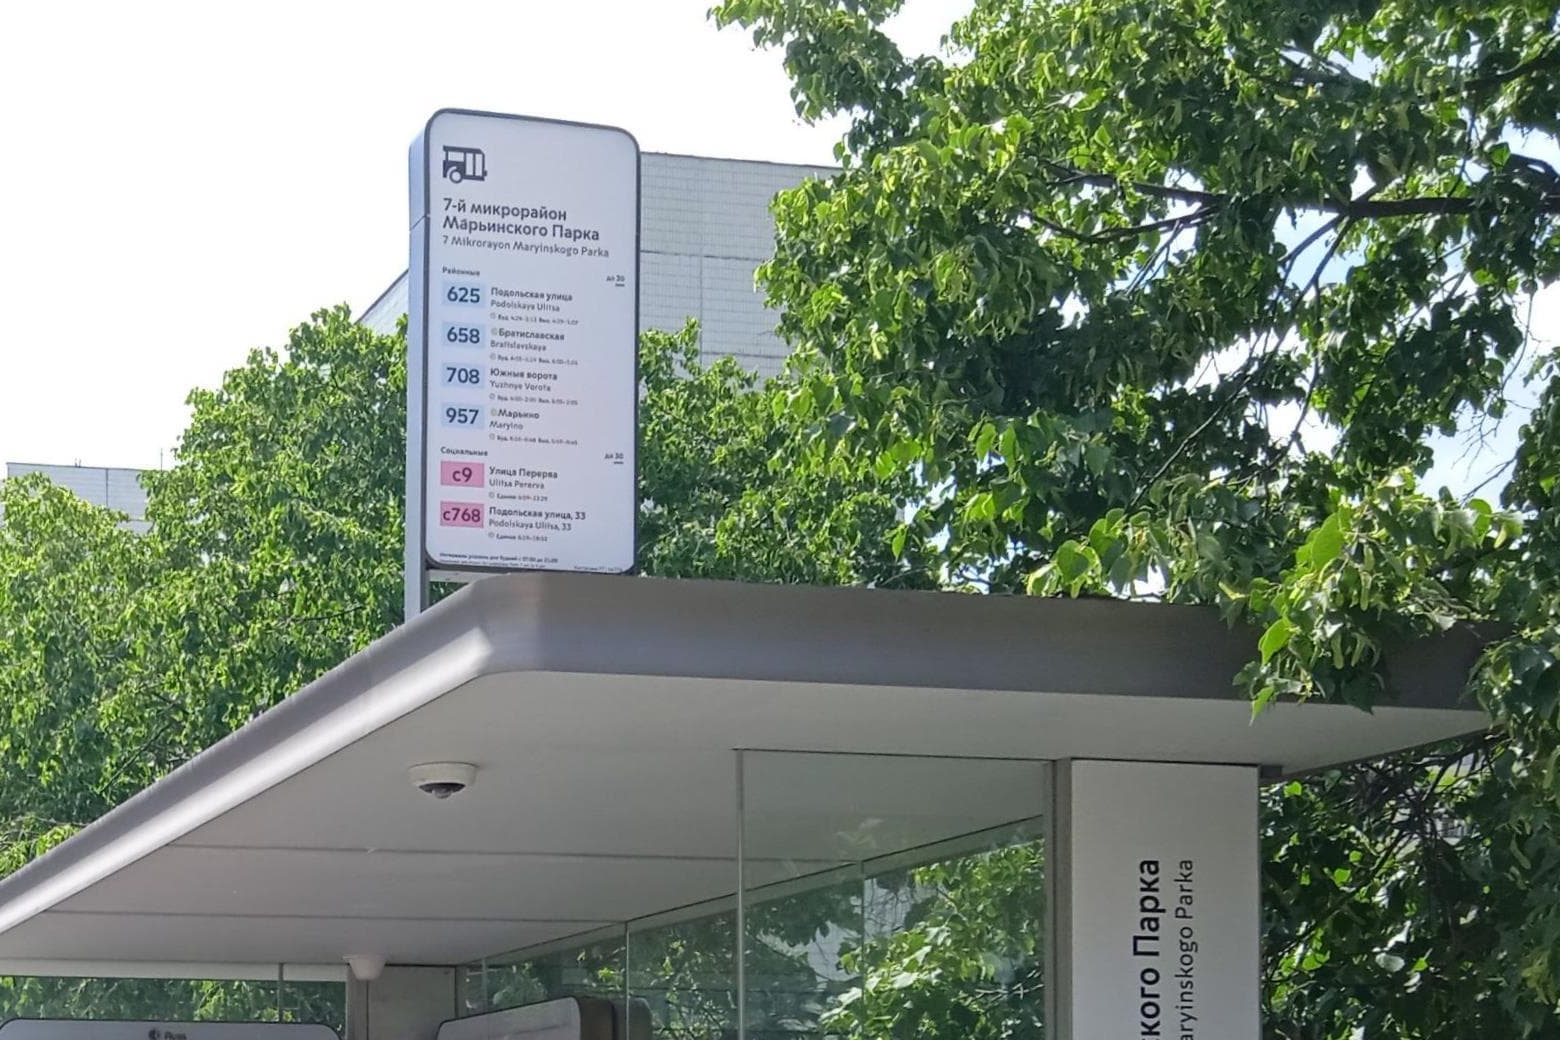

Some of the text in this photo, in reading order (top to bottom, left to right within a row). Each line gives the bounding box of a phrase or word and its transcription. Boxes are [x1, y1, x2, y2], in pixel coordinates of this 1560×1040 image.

[443, 197, 567, 221] 7-й микрорайон
[442, 215, 600, 242] Марьинского Парка
[442, 235, 610, 258] 7 Mikrorayon Maryinskogo Parka
[447, 286, 481, 303] 625
[490, 287, 573, 302] Подольская улица
[447, 327, 481, 344] 658
[498, 328, 565, 340] Братиславская
[446, 367, 480, 384] 708
[446, 407, 479, 424] 957
[497, 409, 540, 420] Марьино
[452, 467, 472, 483] с9
[489, 466, 517, 477] Улица
[442, 507, 481, 523] с768
[489, 507, 543, 518] Подольская
[575, 511, 586, 520] 33
[562, 523, 572, 531] 33
[1174, 859, 1195, 920] Parka
[1133, 859, 1166, 956] Парка
